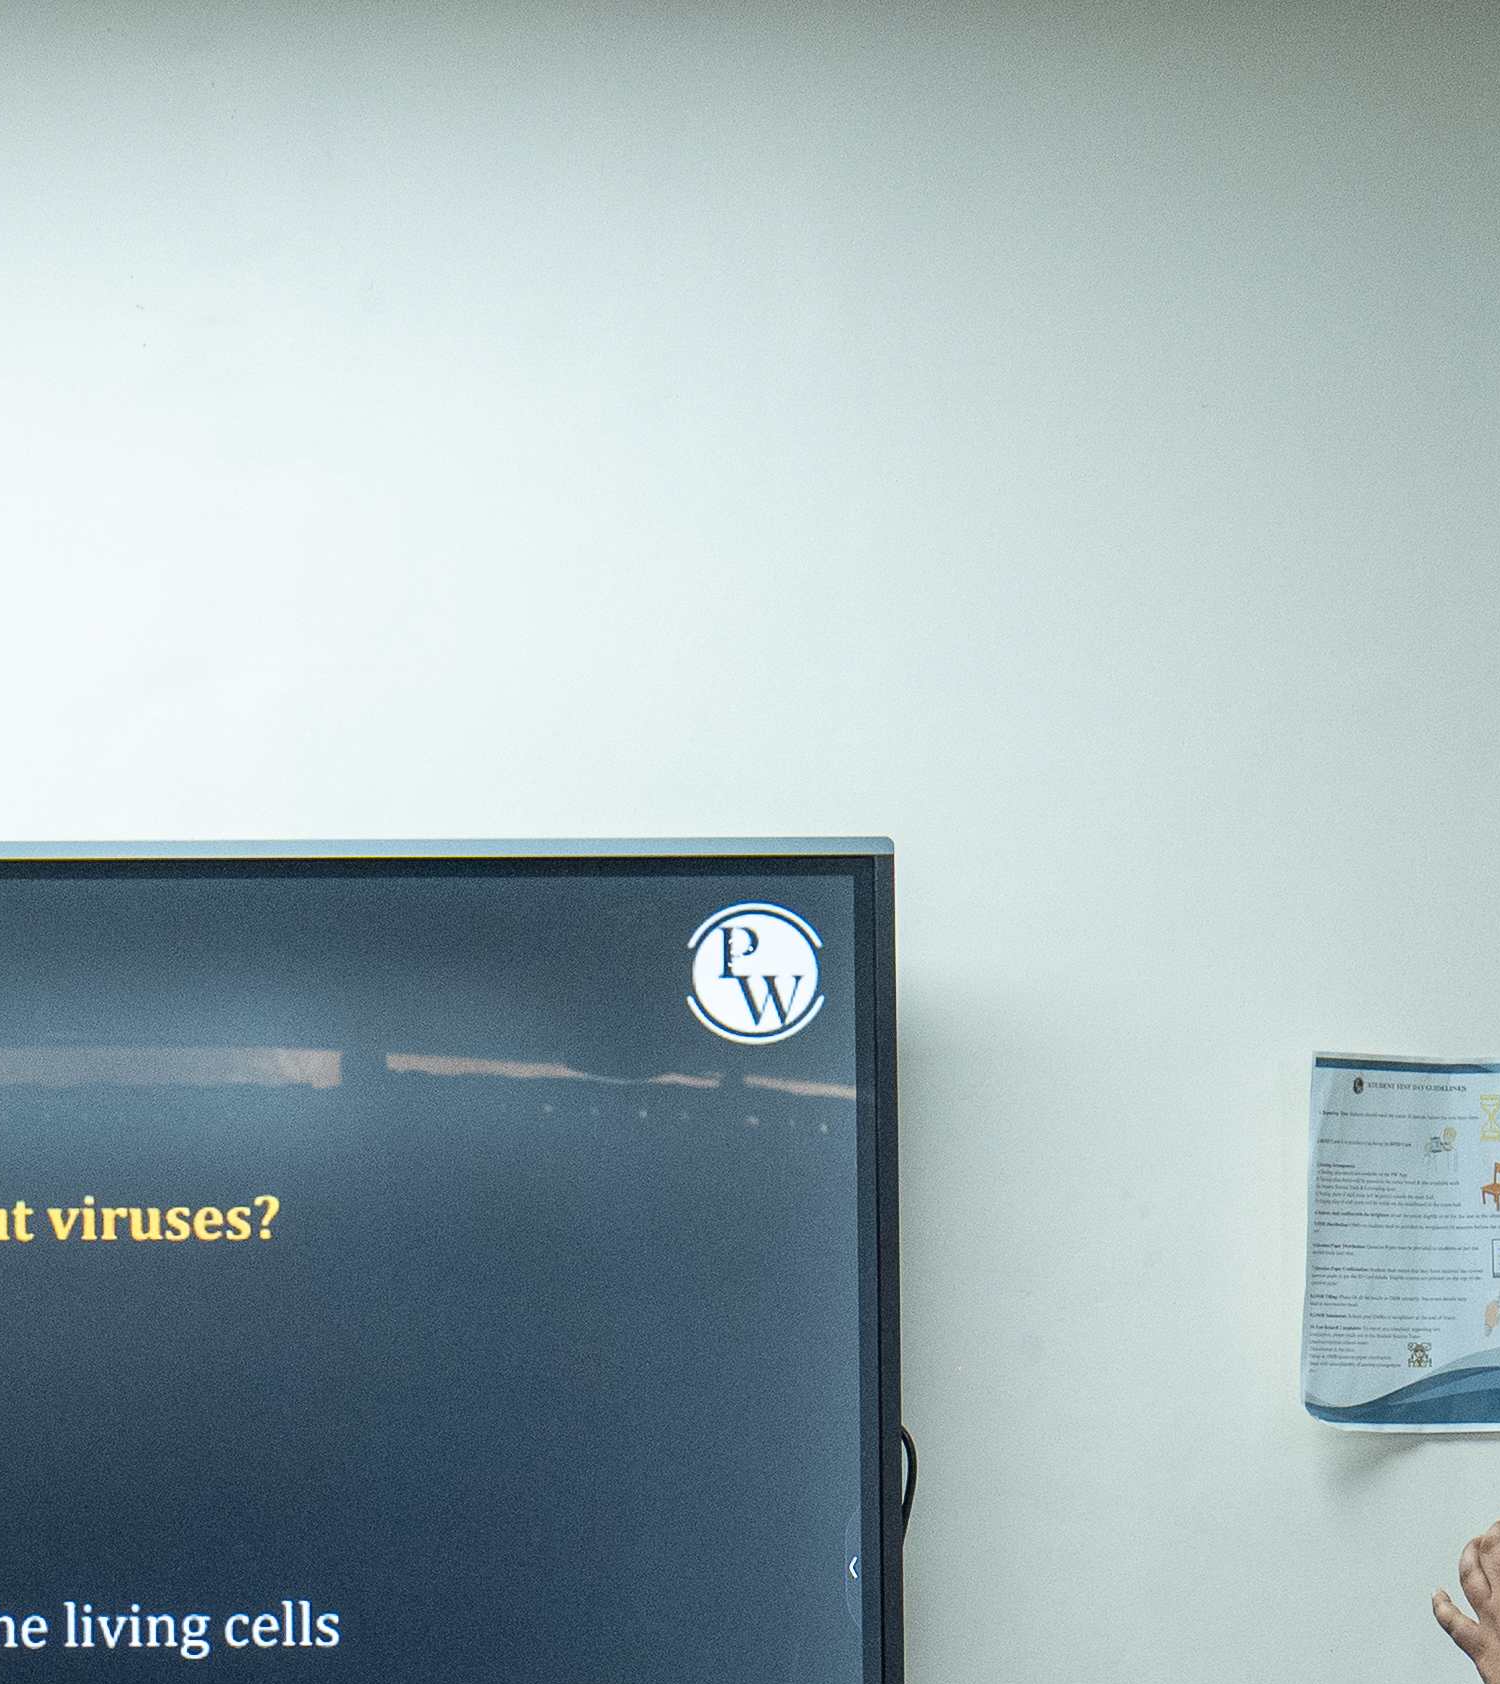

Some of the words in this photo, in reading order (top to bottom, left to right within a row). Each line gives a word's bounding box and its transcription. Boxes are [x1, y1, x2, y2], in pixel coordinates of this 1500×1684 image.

[46, 1194, 280, 1241] viruses?
[63, 1601, 211, 1660] living
[224, 1600, 340, 1648] cells
